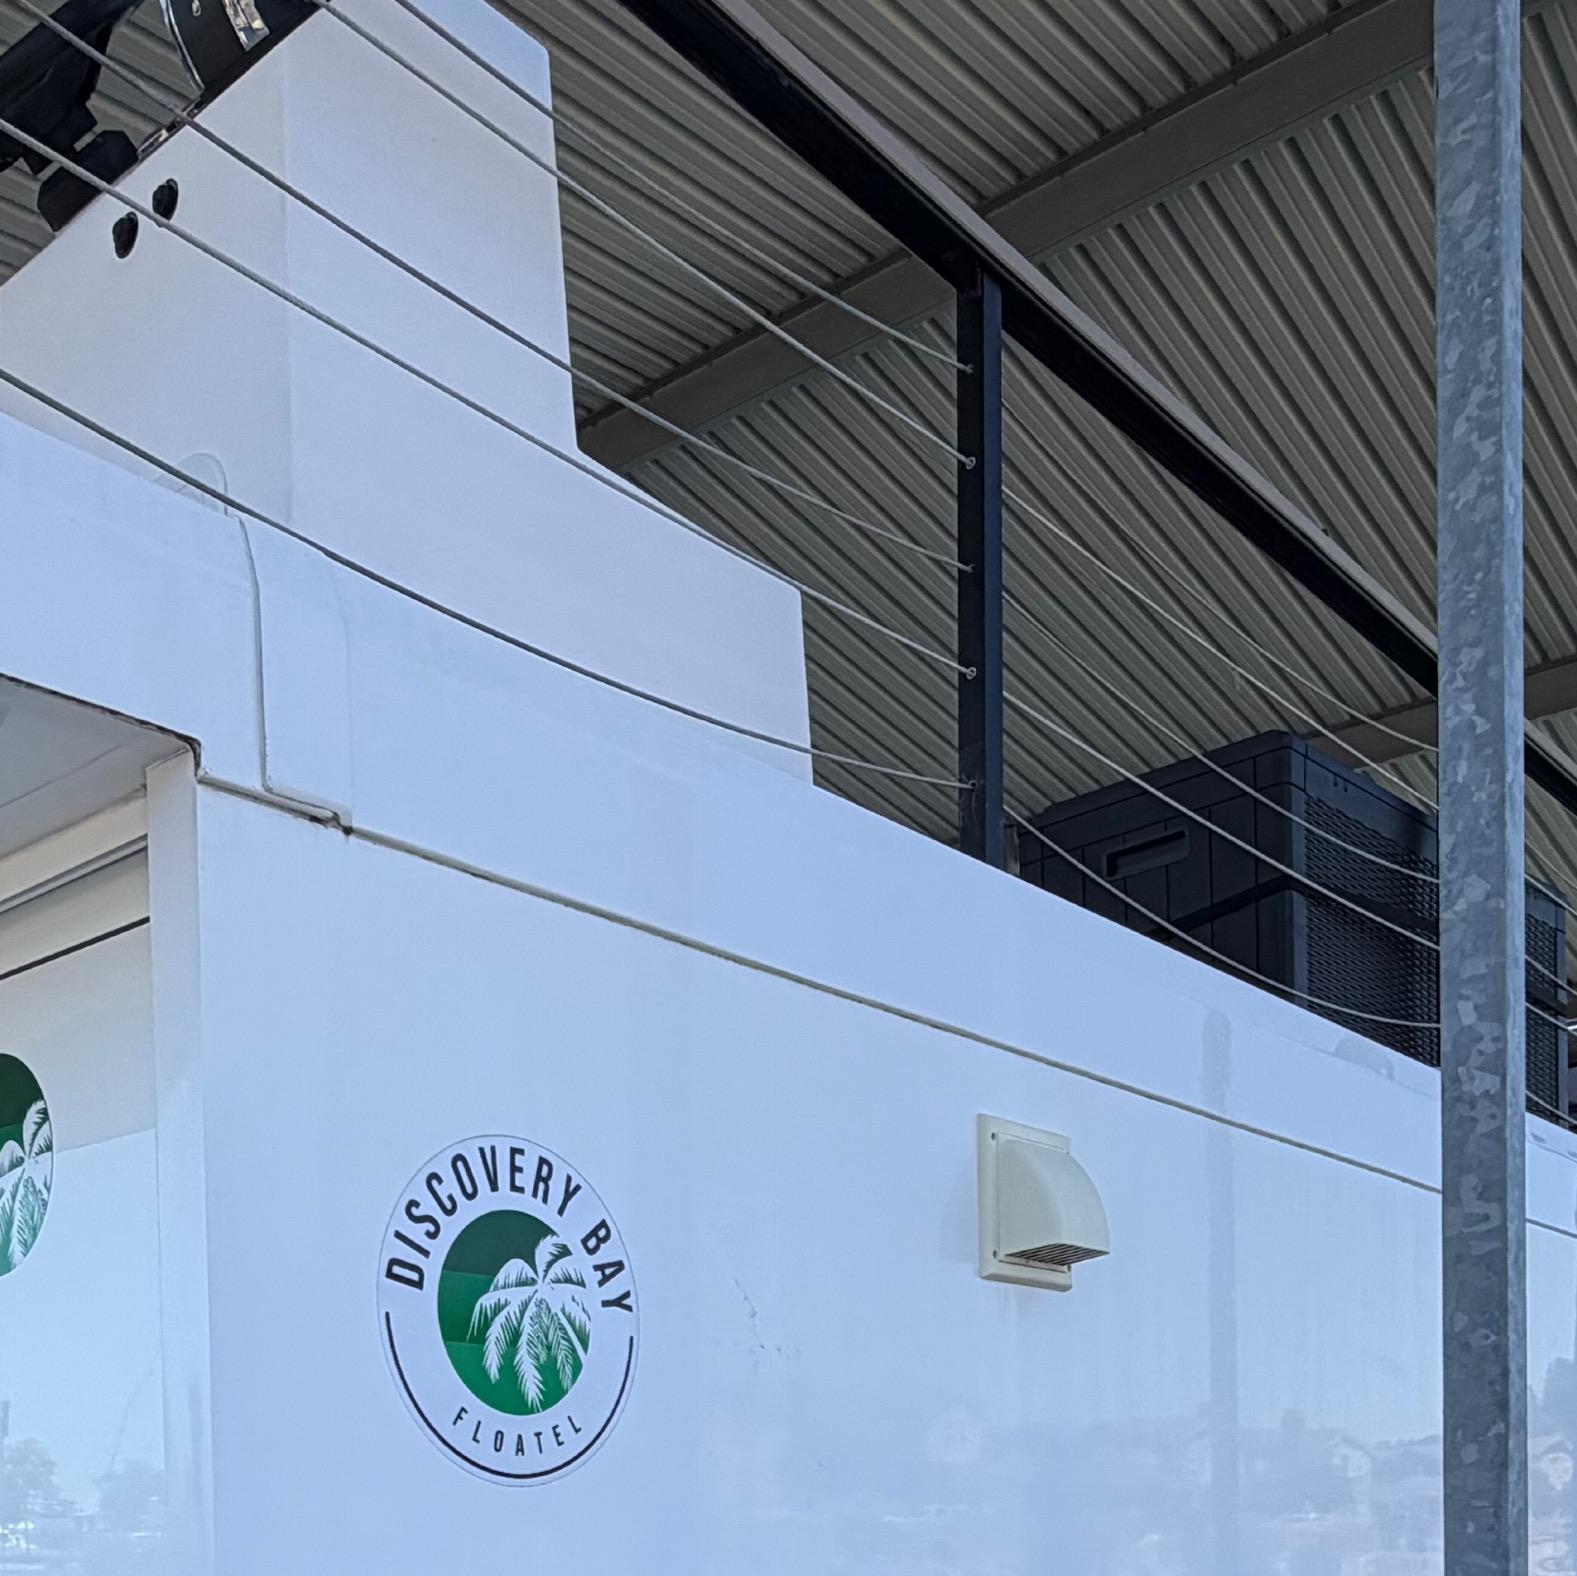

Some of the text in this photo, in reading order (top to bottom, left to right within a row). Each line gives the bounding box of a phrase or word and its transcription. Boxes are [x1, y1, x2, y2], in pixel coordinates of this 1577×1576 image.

[384, 1144, 633, 1314] DISCOVERY BAY
[451, 1406, 582, 1457] FLOATEL
